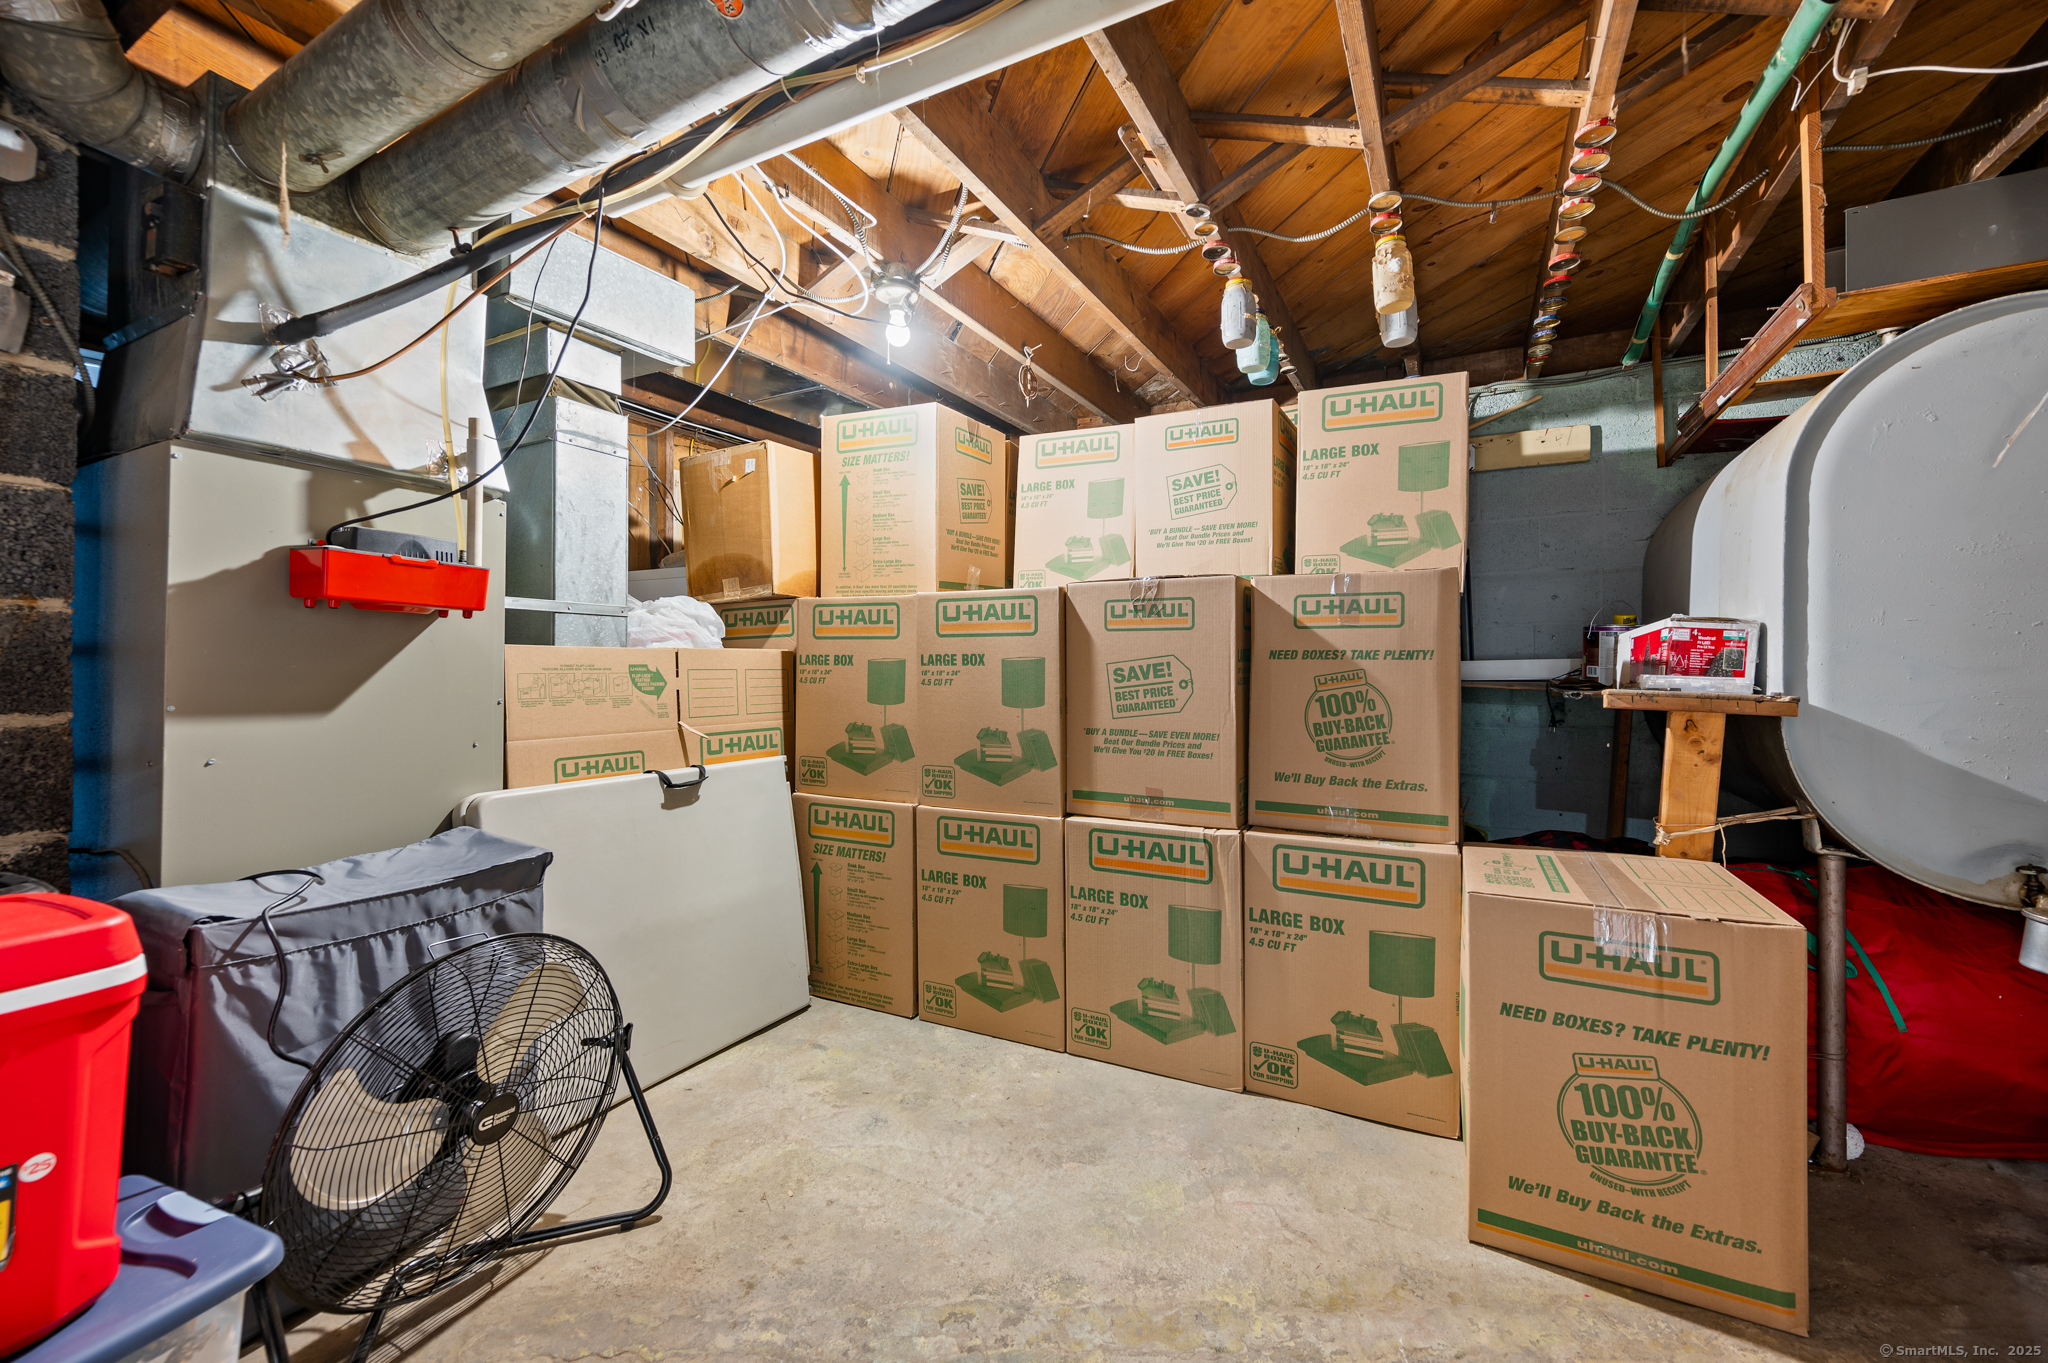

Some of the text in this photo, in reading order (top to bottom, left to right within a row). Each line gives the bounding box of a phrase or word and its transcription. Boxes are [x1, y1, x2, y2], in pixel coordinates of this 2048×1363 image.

[1330, 389, 1434, 416] U-HAUL
[842, 418, 913, 440] U-HAUL
[1170, 423, 1234, 440] U-HAUL
[958, 432, 990, 454] U-HAUL
[1042, 436, 1114, 456] U-HAUL
[842, 451, 910, 467] SIZE MATTERS!
[1303, 443, 1379, 461] LARGE BOX
[1021, 479, 1075, 493] LARGE BOX
[1172, 470, 1220, 491] SAVE!
[960, 483, 984, 496] SAVE!
[1174, 488, 1221, 506] BEST PRICE
[961, 502, 985, 510] BEST PRICE
[943, 602, 1031, 622] U-HAUL
[1110, 603, 1188, 618] U-HAUL
[1301, 598, 1397, 615] U-HAUL
[725, 610, 789, 627] U-HAUL
[819, 609, 893, 625] U-HAUL
[799, 655, 854, 666] LARGE BOX
[921, 654, 985, 666] LARGE BOX
[1269, 650, 1435, 660] NEED BOXES? TAKE PLENTY!
[1113, 662, 1173, 683] SAVE!
[1317, 672, 1364, 686] U-HAUL
[1115, 686, 1173, 702] BEST PRICE
[1315, 688, 1377, 718] 100%
[1313, 714, 1387, 737] BUY-BACK
[707, 733, 778, 755] U-HAUL
[1193, 733, 1220, 741] MORE!
[1315, 732, 1391, 753] GUARANTEE
[1187, 742, 1202, 750] and
[1187, 751, 1213, 759] Boxes!
[1365, 750, 1386, 766] RECEIPT
[561, 757, 640, 777] U-HAUL
[934, 780, 952, 790] OK
[1304, 774, 1325, 786] Buy
[1329, 776, 1358, 787] Back
[1363, 778, 1382, 789] the
[1385, 780, 1428, 792] Extras.
[1124, 796, 1175, 806] uhaul.com
[814, 809, 889, 832] U-HAUL
[1317, 807, 1378, 819] uhaul.com
[944, 823, 1033, 848] U-HAUL
[814, 843, 886, 863] SIZE MATTERS!
[1097, 836, 1204, 866] U-HAUL
[1283, 852, 1415, 888] U-HAUL
[922, 869, 987, 889] LARGE BOX
[1070, 885, 1149, 909] LARGE BOX
[1070, 913, 1109, 925] 4.5 CU FT
[1249, 907, 1345, 935] LARGE BOX
[1250, 926, 1262, 934] 18"
[1271, 929, 1285, 938] 18"
[1294, 933, 1307, 941] 24"
[1249, 937, 1296, 952] 4.5 CU FT
[1551, 940, 1707, 983] U-HAUL
[1082, 1013, 1107, 1023] U-HAUL
[1082, 1019, 1108, 1027] BOXES
[1086, 1025, 1107, 1039] OK
[1499, 1002, 1771, 1061] NEED BOXES? TAKE PLENTY!
[1085, 1036, 1107, 1046] SHIPPING
[1264, 1048, 1295, 1059] U-HAUL
[1264, 1054, 1295, 1065] BOXES
[1267, 1063, 1293, 1078] OK
[1578, 1056, 1653, 1071] U-HAUL
[1266, 1074, 1294, 1085] SHIPPING
[1575, 1083, 1676, 1122] 100%
[1571, 1119, 1693, 1150] BUY-BACK
[1575, 1145, 1699, 1174] GUARANTEE
[1657, 1180, 1692, 1197] RECEIPT
[1556, 1189, 1592, 1212] Buy
[1596, 1200, 1646, 1225] Back
[1652, 1214, 1684, 1234] the
[1690, 1224, 1763, 1254] Extras.
[1577, 1238, 1679, 1276] uhaul.com
